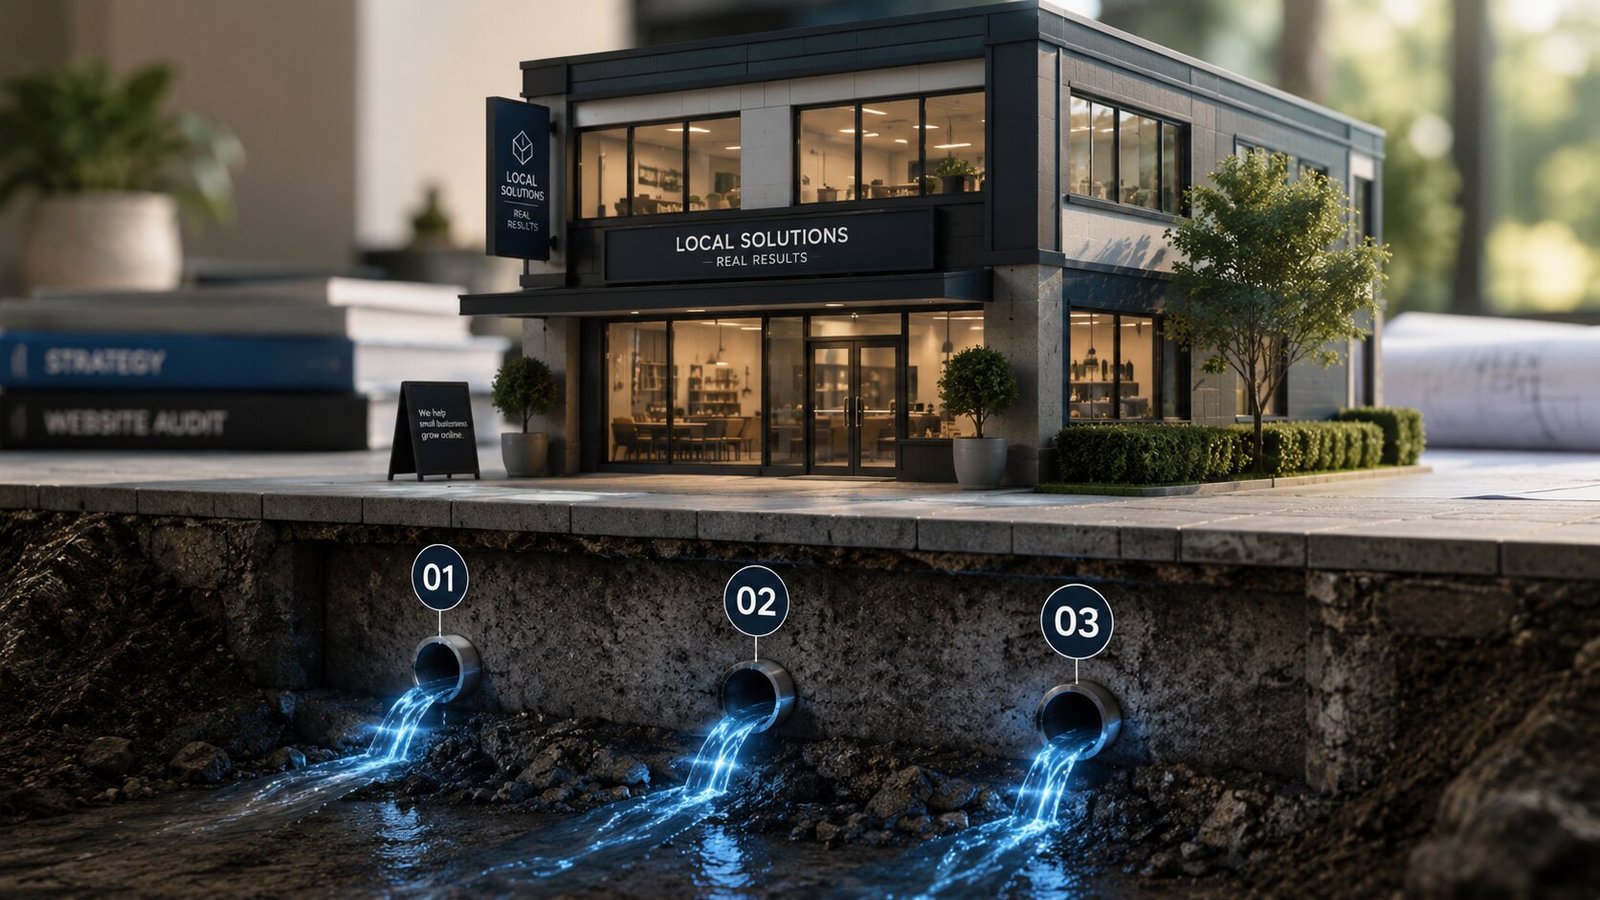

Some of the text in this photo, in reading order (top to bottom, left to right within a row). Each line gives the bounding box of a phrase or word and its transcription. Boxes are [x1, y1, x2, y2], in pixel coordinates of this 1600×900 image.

[506, 170, 538, 187] LOCAL
[501, 185, 545, 201] SOLUTIONS
[513, 209, 531, 220] REAL
[676, 226, 849, 252] LOCAL SOLUTIONS
[716, 252, 808, 267] REAL RESULTS
[45, 348, 167, 375] STRATEGY
[418, 409, 431, 417] We
[44, 408, 228, 436] WEBSITE AUDIT
[421, 432, 440, 441] grow
